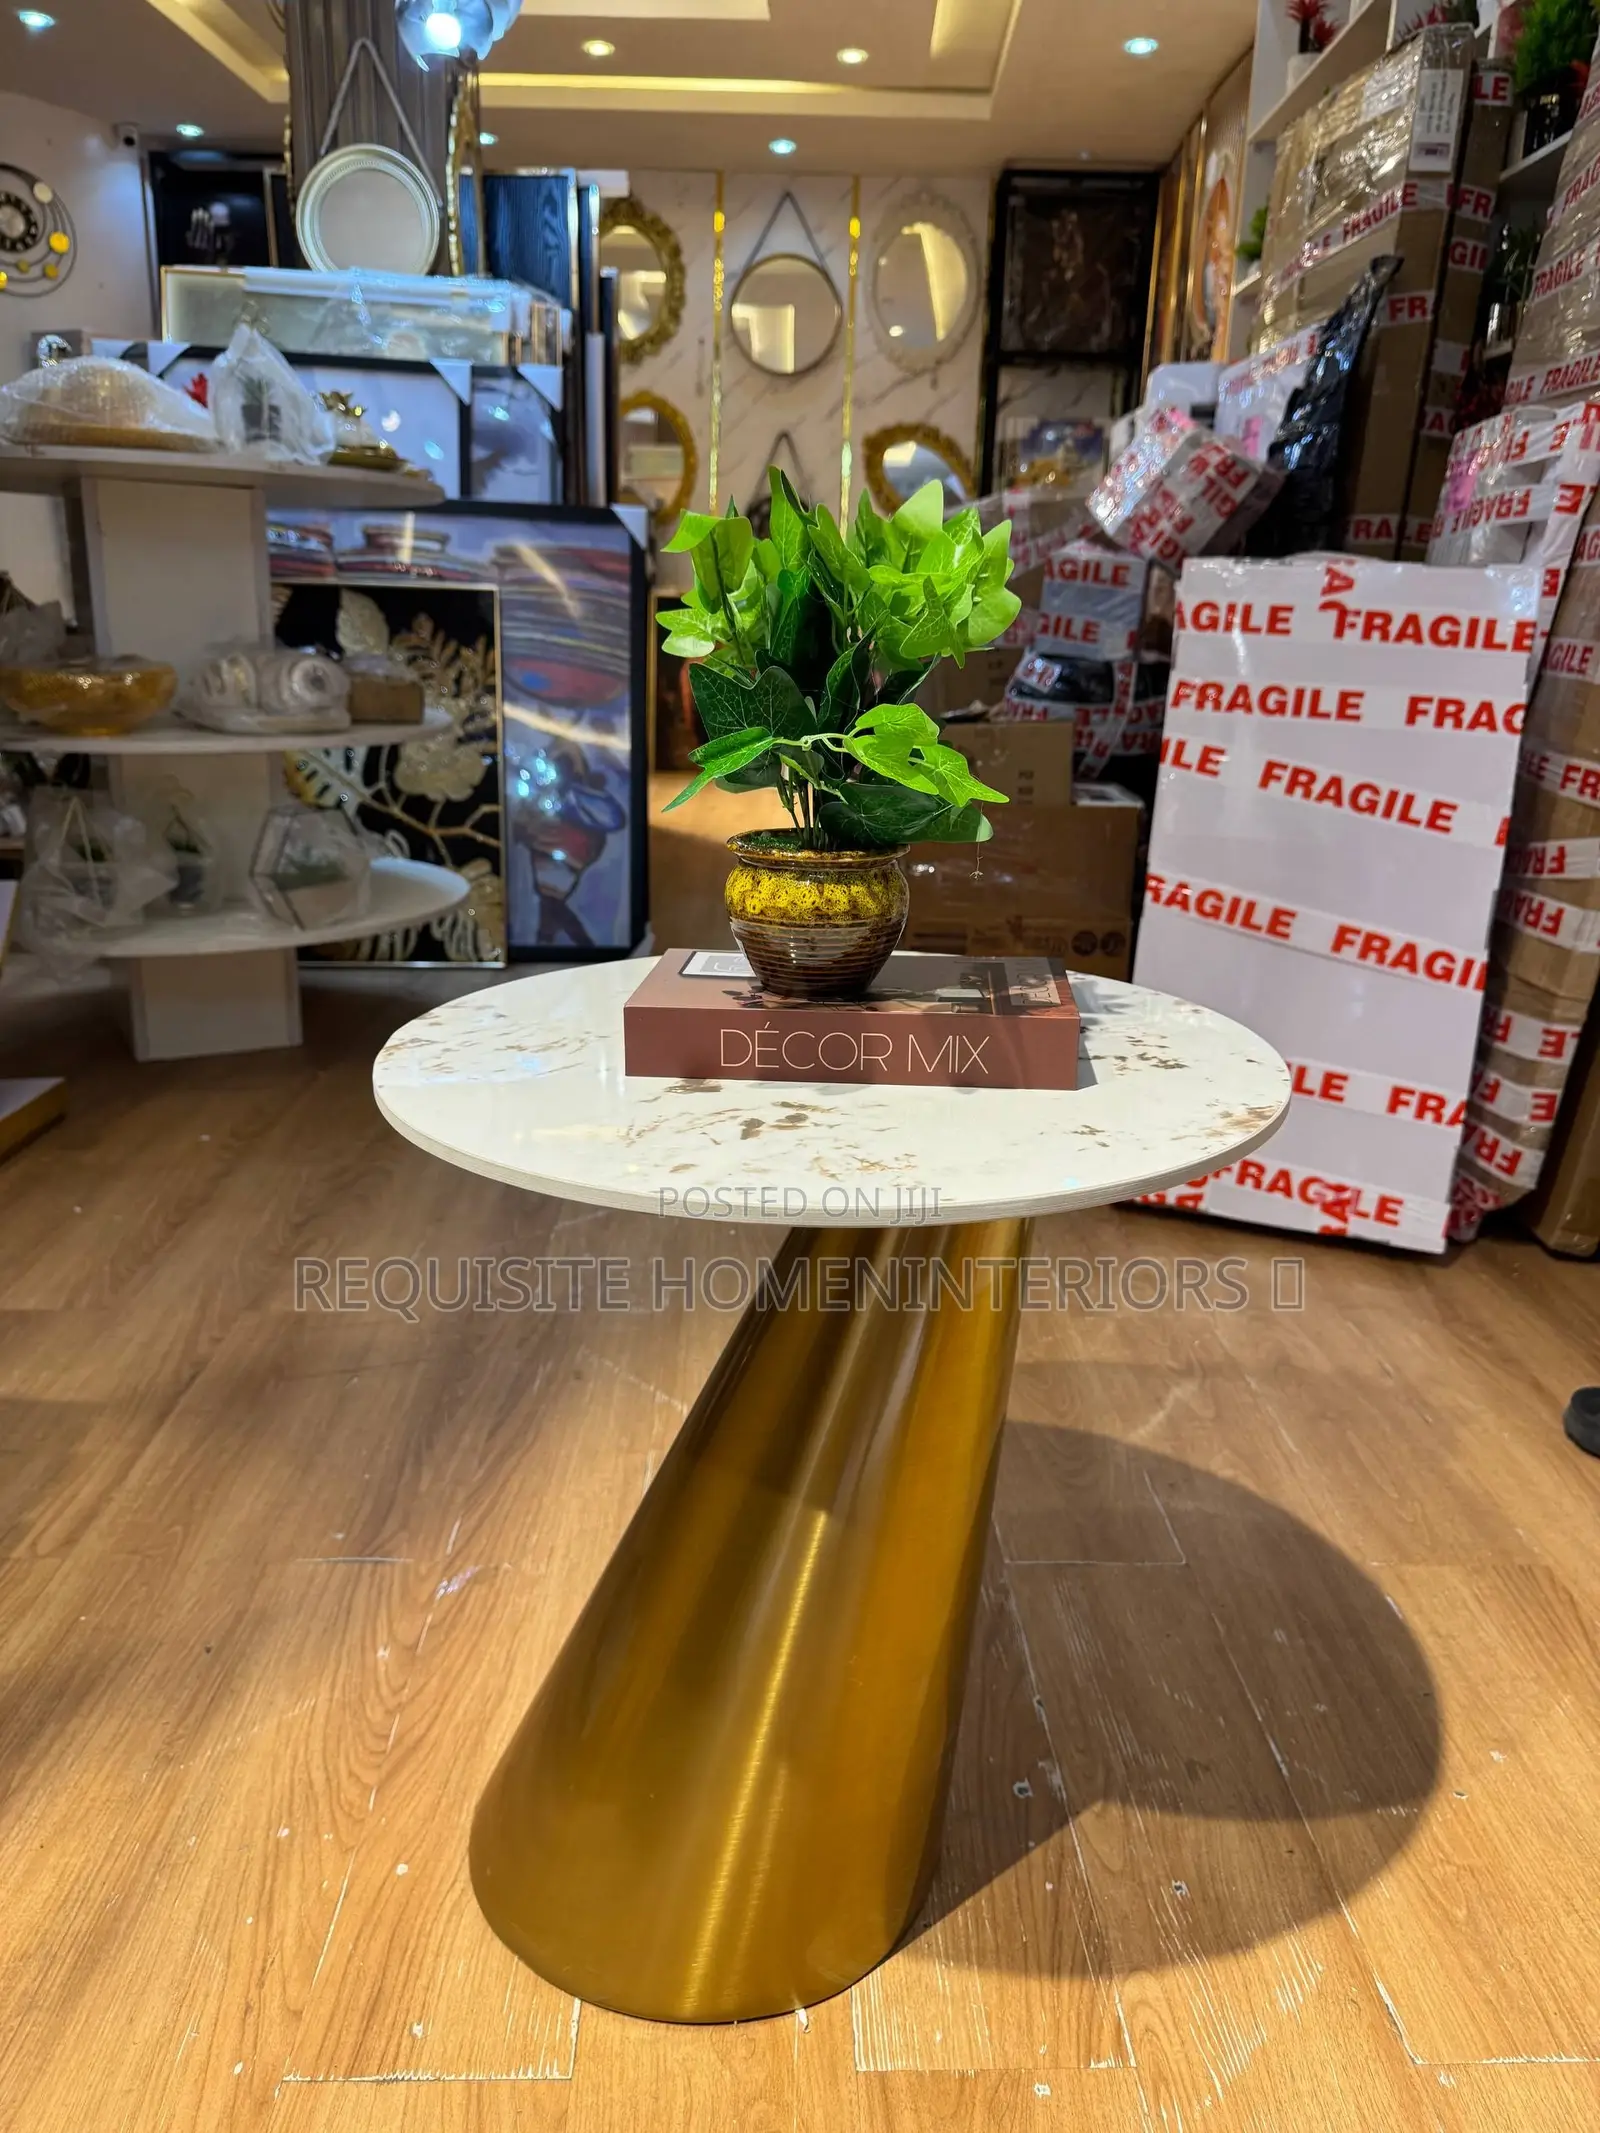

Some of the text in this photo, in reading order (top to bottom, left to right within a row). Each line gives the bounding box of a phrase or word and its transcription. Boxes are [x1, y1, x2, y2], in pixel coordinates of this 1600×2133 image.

[1333, 607, 1537, 653] FRAGILE
[1171, 680, 1366, 723] FRAGILE
[1259, 760, 1460, 835] FRAGILE
[720, 1021, 990, 1075] DÉCOR MIX
